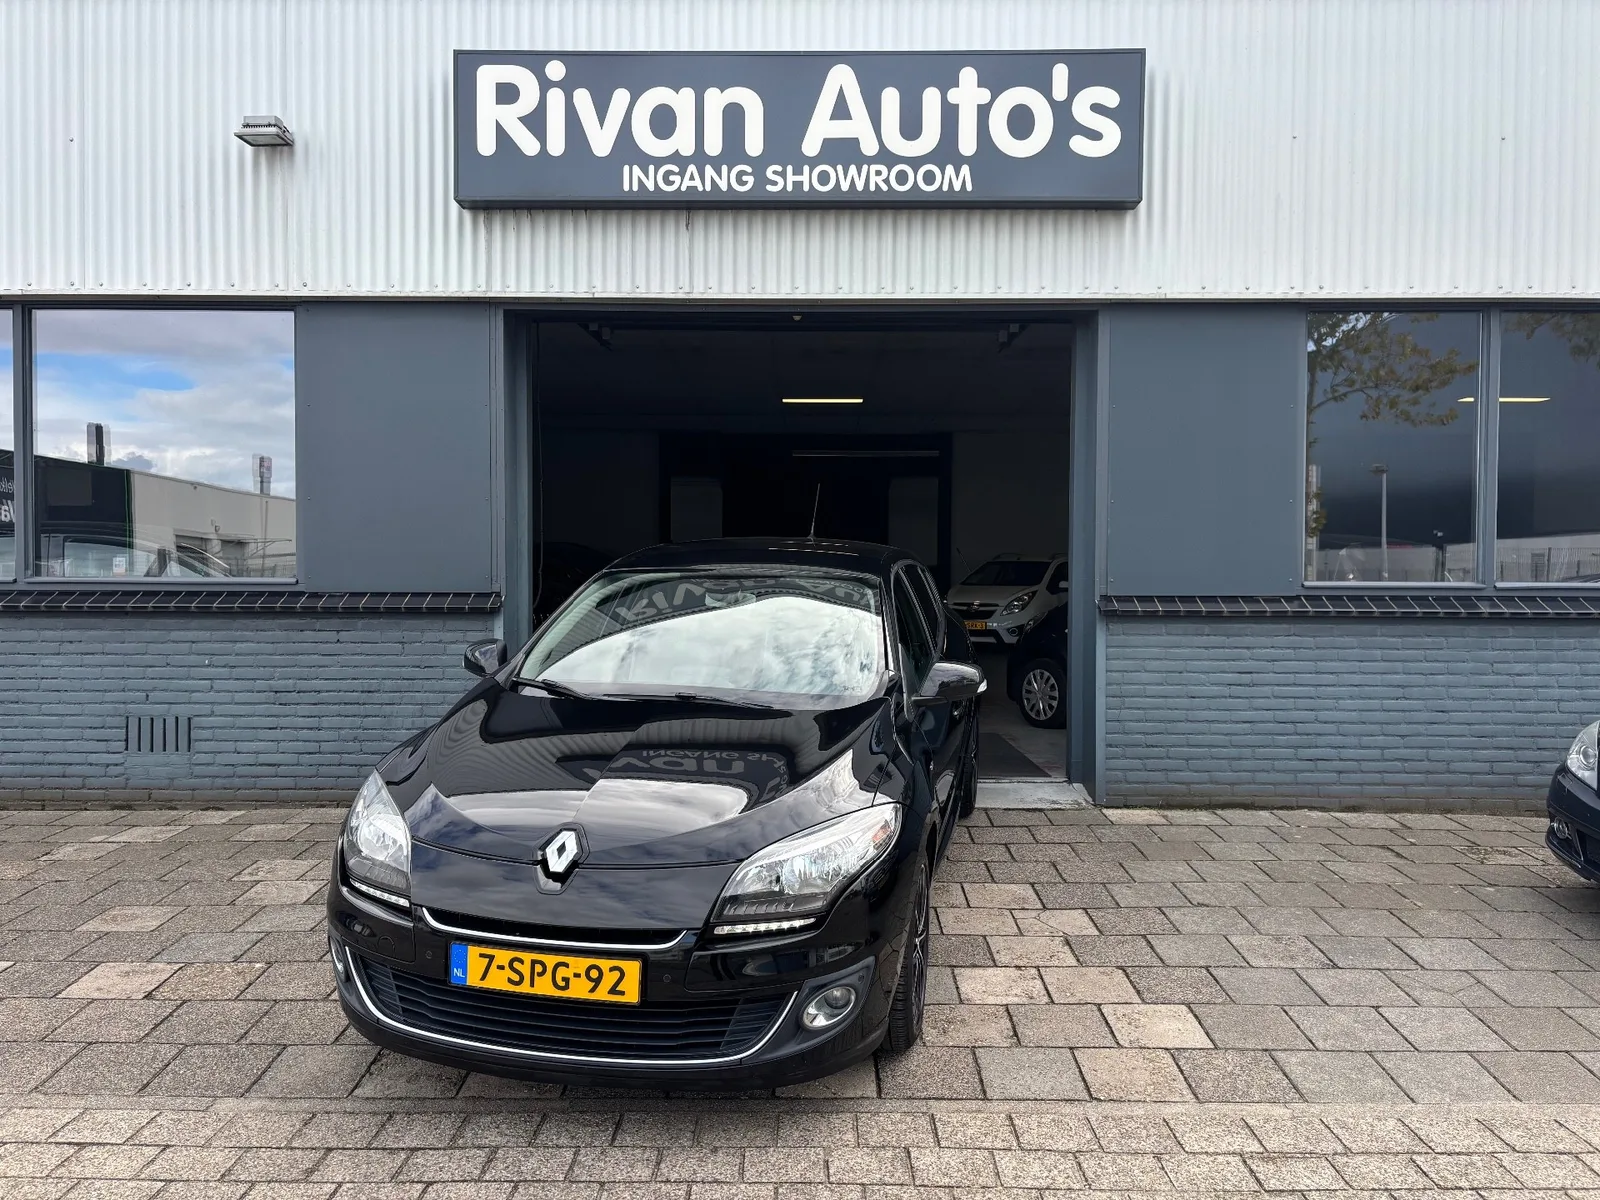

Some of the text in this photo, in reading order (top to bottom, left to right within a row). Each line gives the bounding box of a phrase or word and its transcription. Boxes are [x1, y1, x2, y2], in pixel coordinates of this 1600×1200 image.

[476, 59, 1122, 159] Rivan Auto's
[622, 163, 973, 193] INGANG SHOWROOM
[453, 952, 626, 996] NL 7-SPG-92
